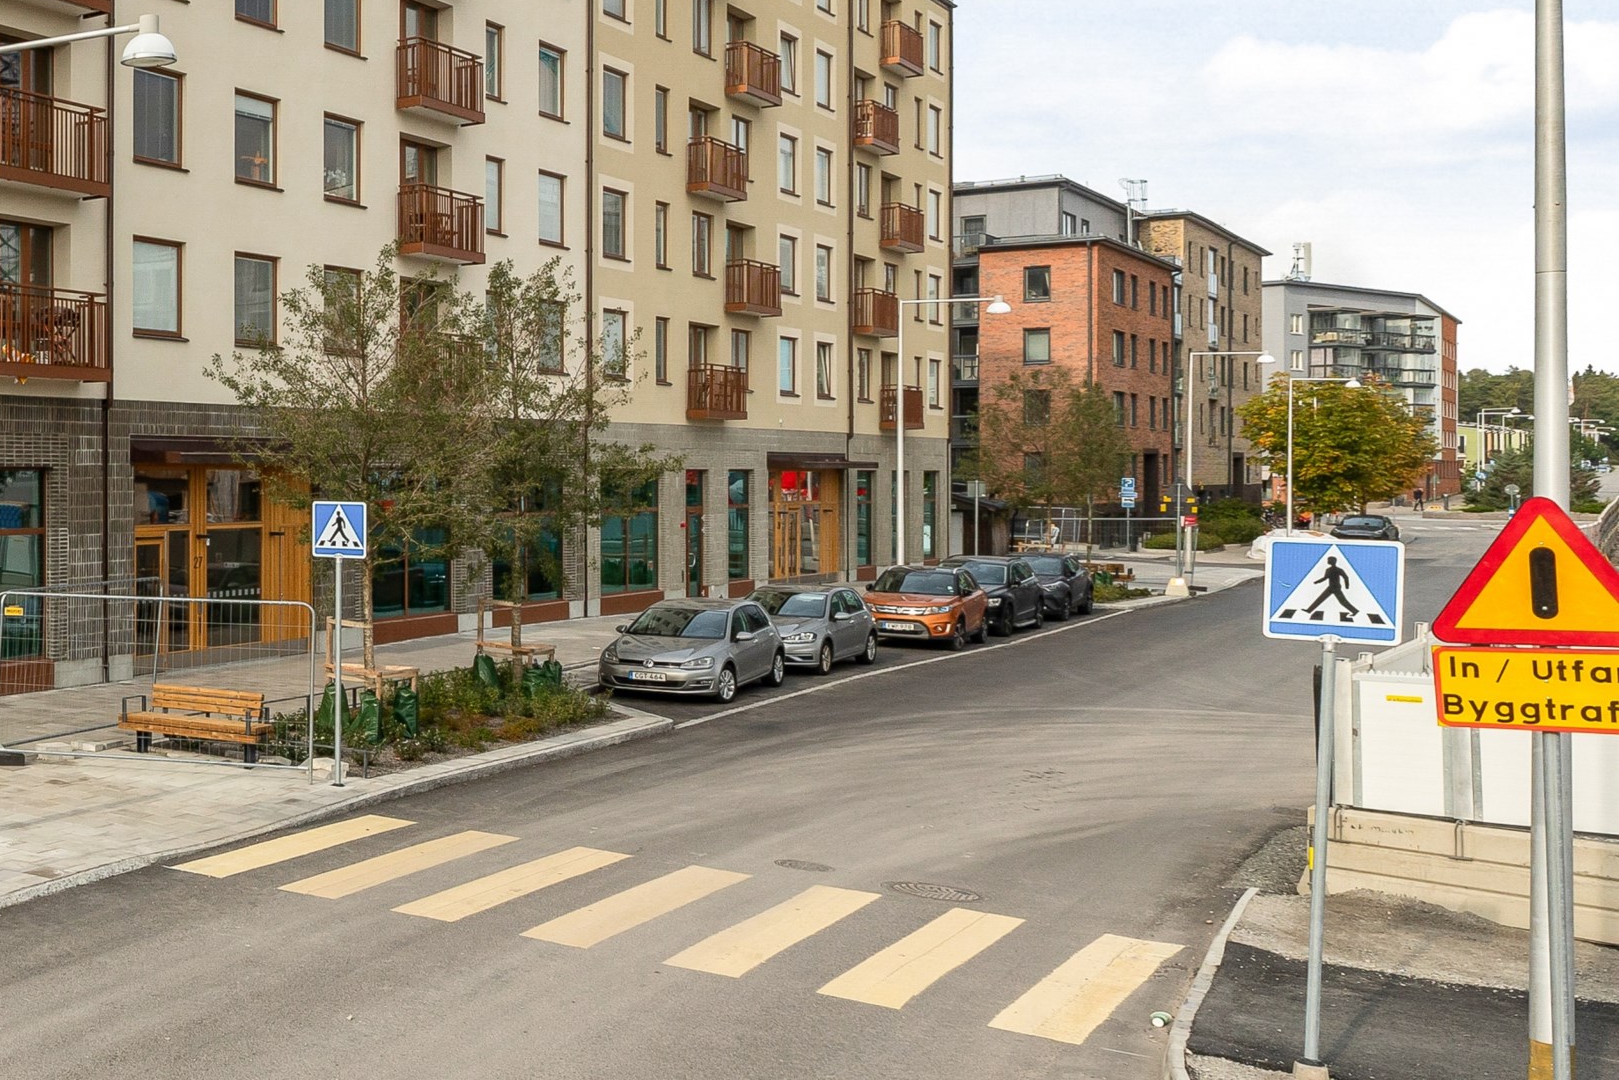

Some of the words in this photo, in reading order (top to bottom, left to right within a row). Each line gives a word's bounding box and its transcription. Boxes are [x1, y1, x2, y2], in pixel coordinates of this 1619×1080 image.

[193, 556, 203, 569] 27
[1449, 656, 1480, 678] In
[1496, 659, 1510, 683] /
[1532, 660, 1619, 683] Utfa
